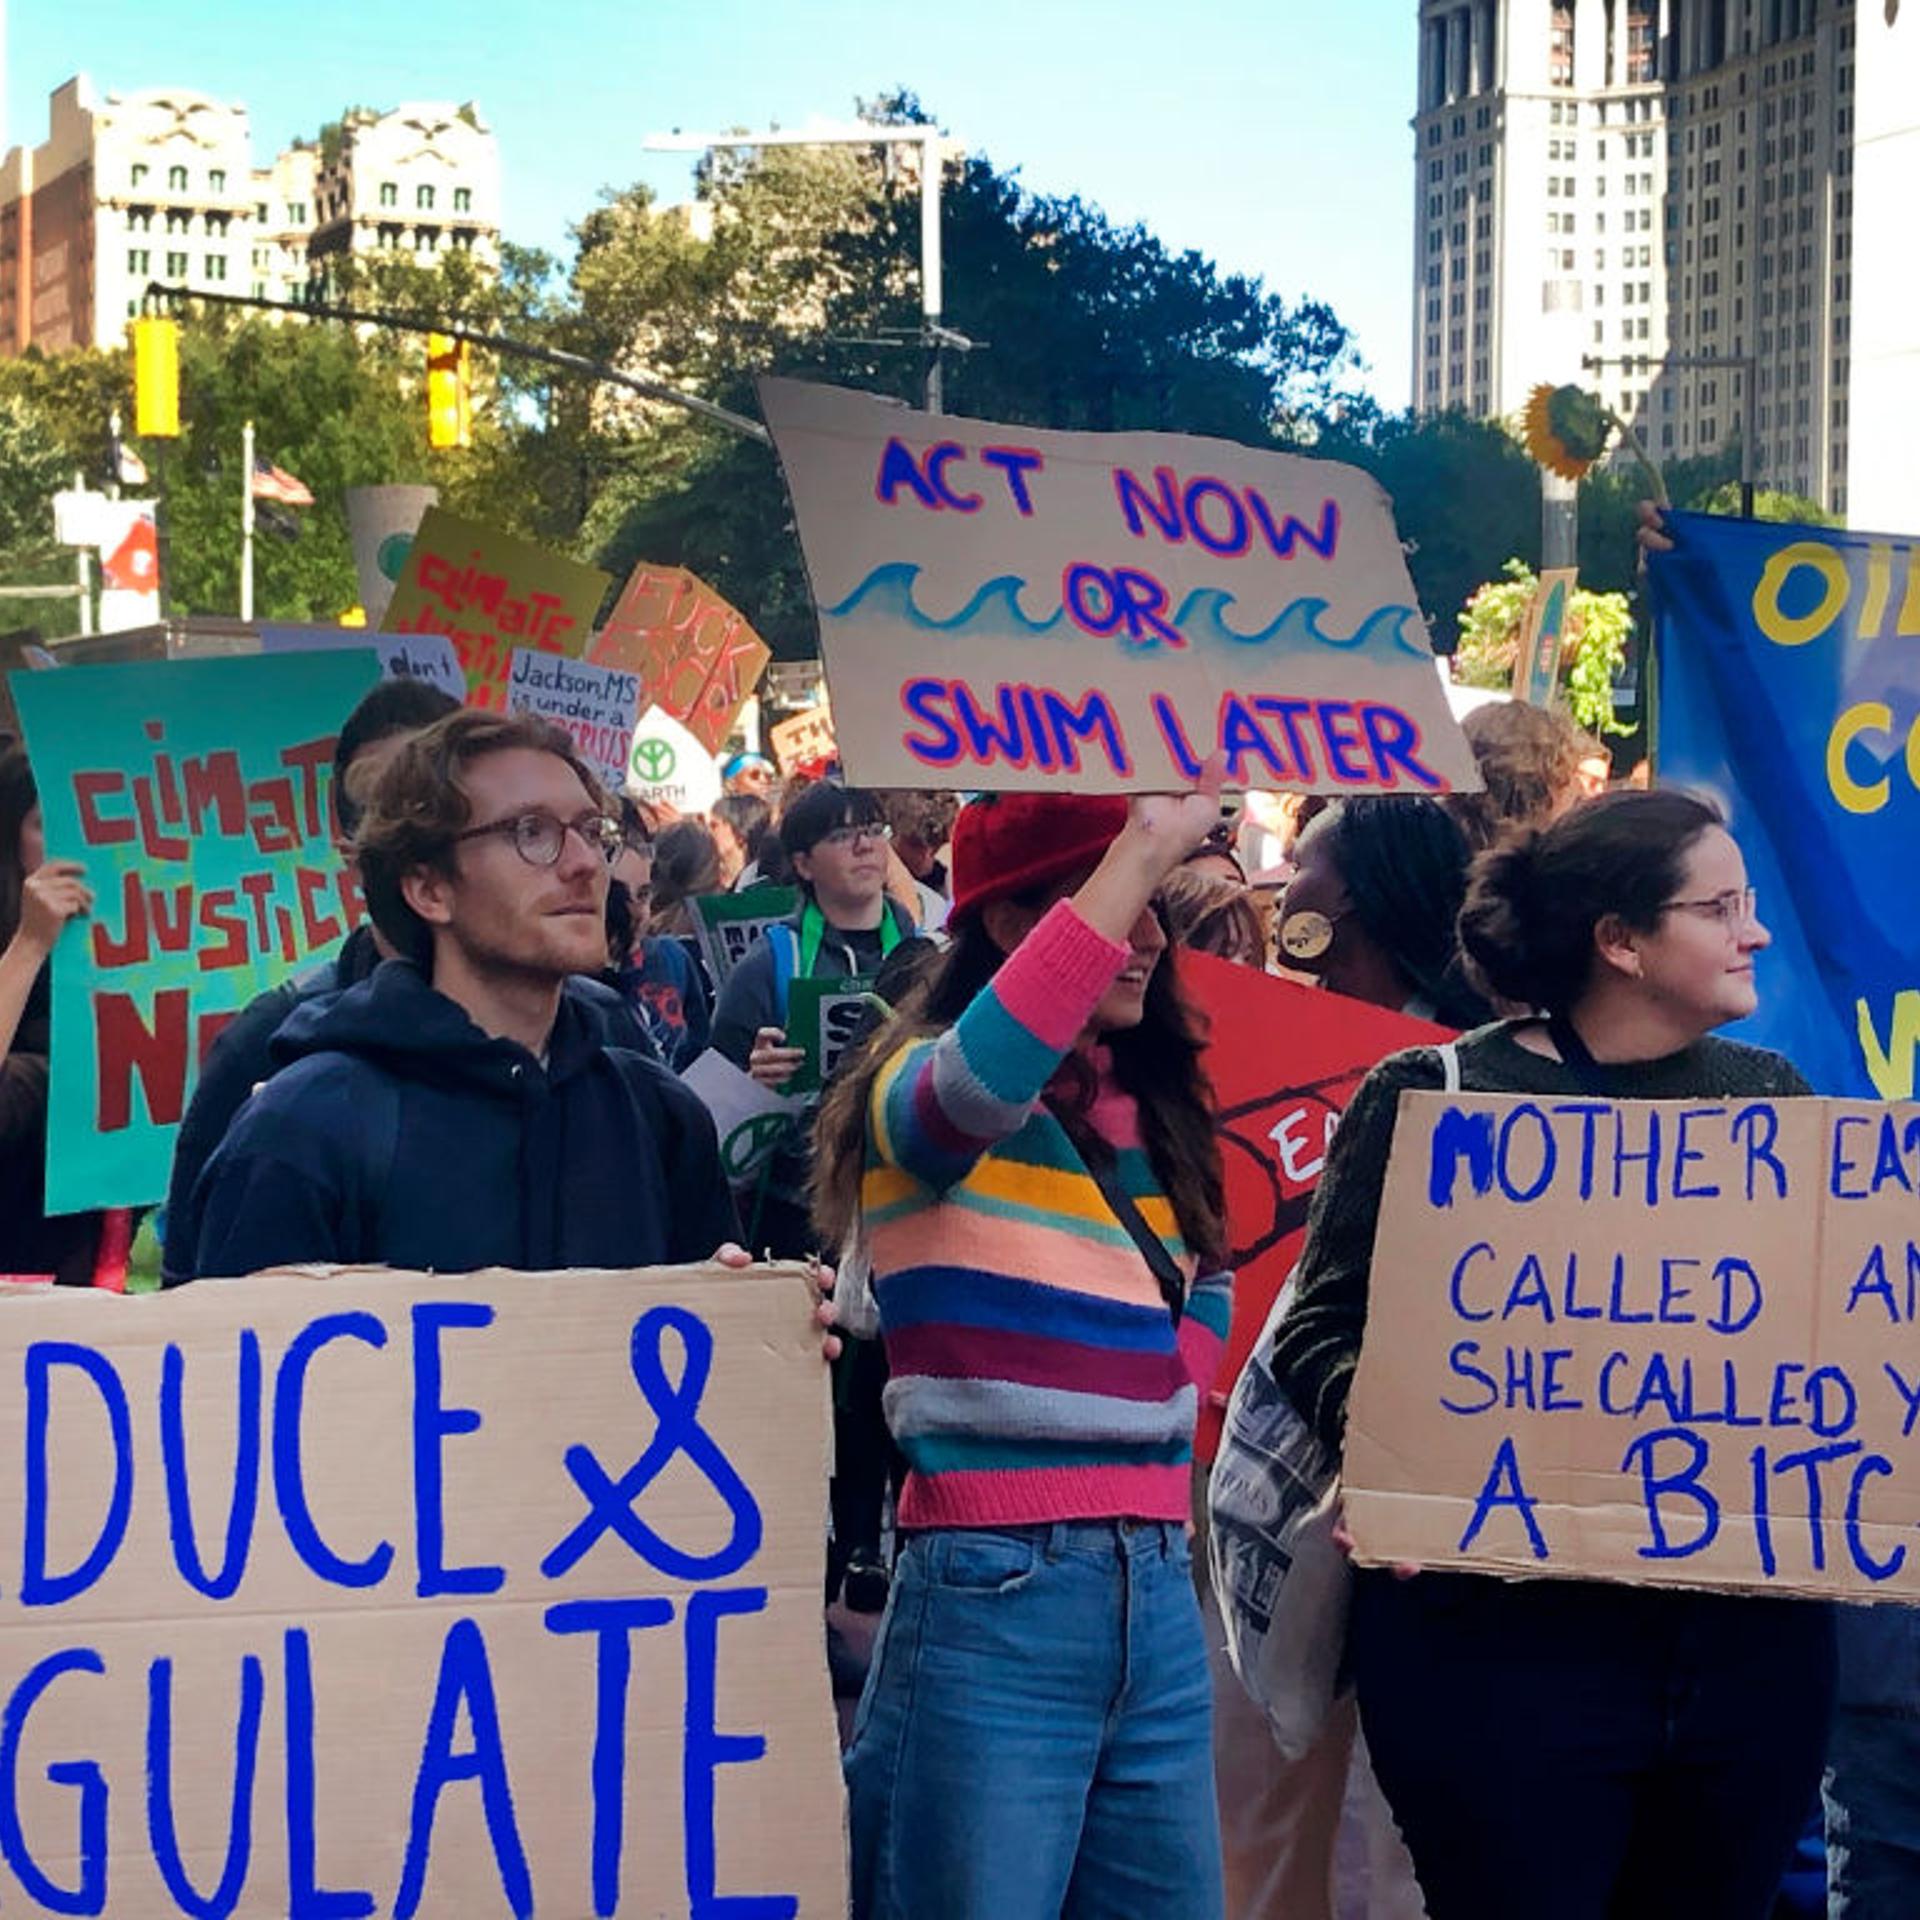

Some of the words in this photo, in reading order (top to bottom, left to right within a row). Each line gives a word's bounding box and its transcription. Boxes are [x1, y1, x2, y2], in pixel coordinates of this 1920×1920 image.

[876, 437, 1042, 516] ACT
[1113, 466, 1340, 561] NOW
[1061, 561, 1188, 650] OR
[536, 698, 606, 721] under
[609, 711, 625, 728] a
[901, 678, 1135, 778] SWIM
[1152, 690, 1451, 794] LATER
[1826, 702, 1920, 815] C
[634, 783, 687, 801] ARTH
[1429, 1102, 1788, 1208] MOTHER
[1449, 1242, 1763, 1334] CALLED
[540, 1305, 764, 1582] &
[1440, 1340, 1583, 1415] SHE
[1599, 1350, 1859, 1438] CALLED
[1459, 1436, 1550, 1560] A
[1621, 1427, 1920, 1582] BITC
[0, 1586, 799, 1920] GULATE
